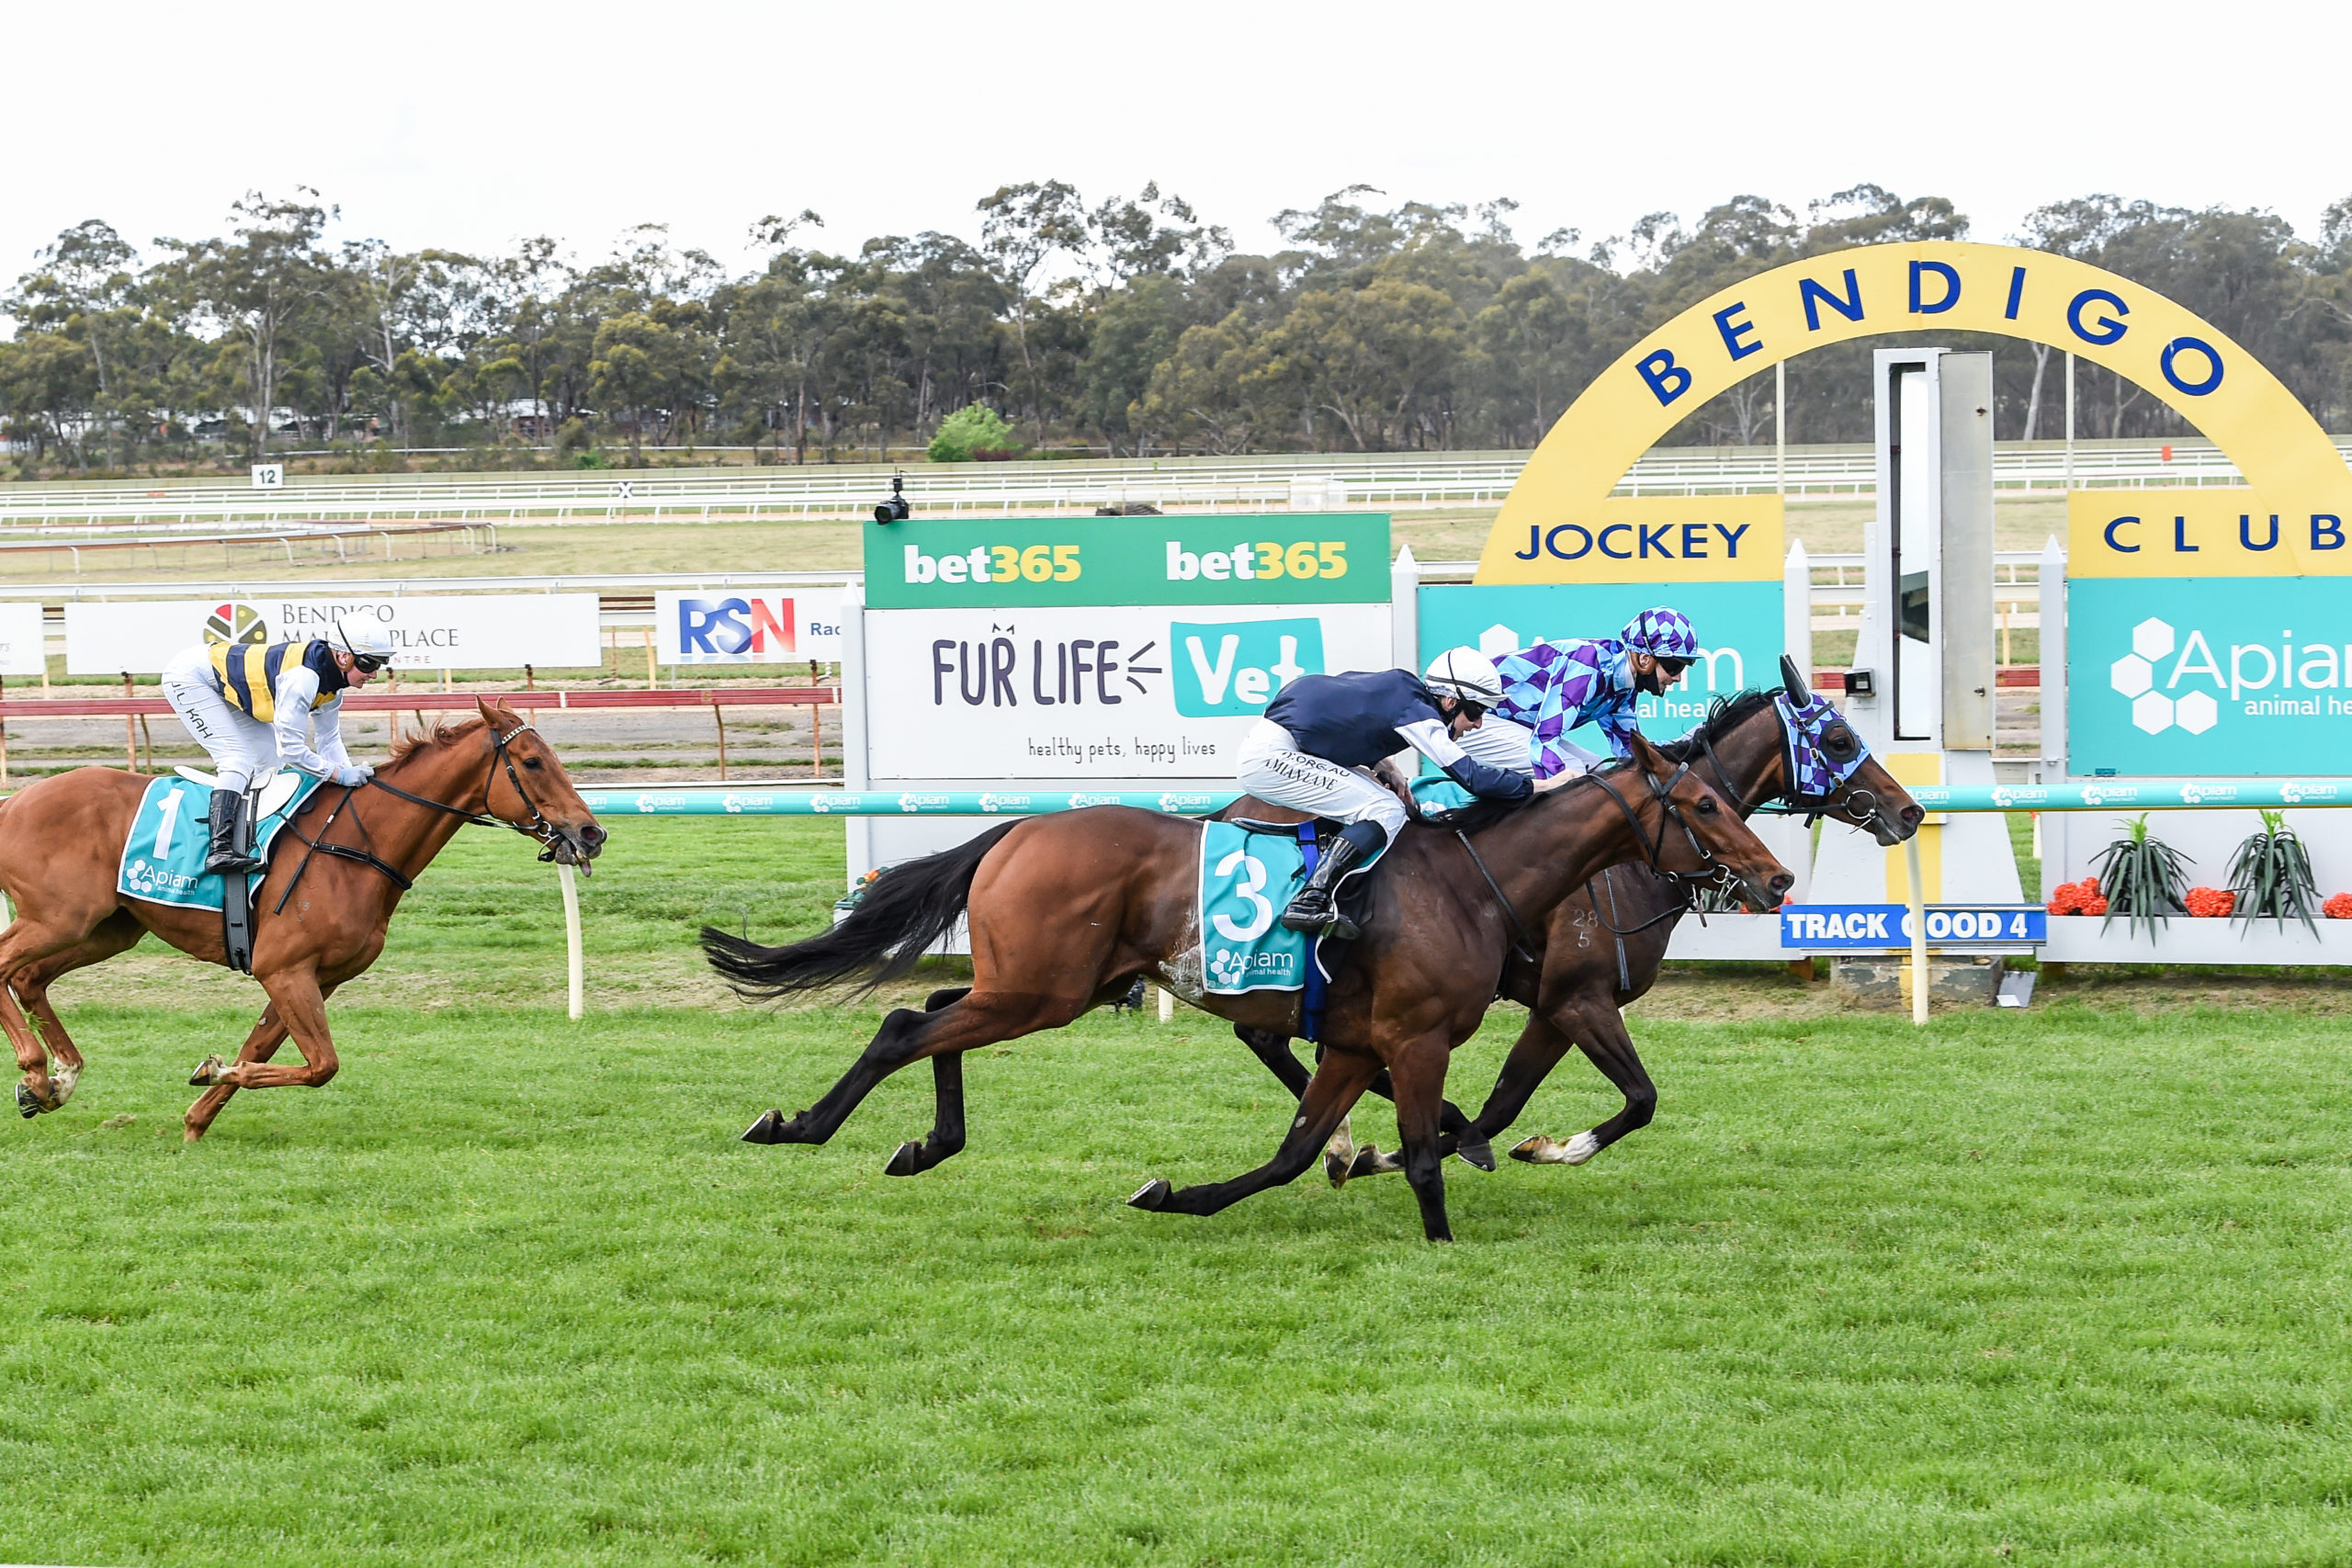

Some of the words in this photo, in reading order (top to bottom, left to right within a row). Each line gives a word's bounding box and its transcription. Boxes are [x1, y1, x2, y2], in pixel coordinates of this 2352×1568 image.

[1634, 260, 2224, 407] BENDIGO
[259, 469, 276, 484] 12
[1514, 524, 1751, 560] JOCKEY
[2104, 514, 2346, 553] CLUB
[904, 544, 1082, 583] bet365
[1166, 540, 1348, 581] bet365
[678, 597, 796, 655] RSN
[933, 637, 1017, 706] FUR
[1033, 638, 1122, 705] LIFE
[1185, 634, 1306, 705] Vet
[2165, 629, 2352, 701] Apia
[2245, 694, 2320, 716] animal
[186, 708, 213, 739] KAH
[1029, 737, 1082, 764] healthy
[1089, 737, 1126, 763] pets,
[1135, 737, 1175, 763] happy
[1182, 736, 1216, 755] lives
[646, 795, 685, 807] Apiam
[734, 795, 773, 807] Apiam
[820, 795, 860, 807] Apiam
[909, 794, 949, 806] Apiam
[989, 794, 1030, 806] Apiam
[1079, 794, 1120, 805] Apiam
[1169, 794, 1211, 806] Apiam
[2001, 787, 2047, 800] Apiam
[2091, 786, 2137, 798] Apiam
[2190, 784, 2237, 797] Apiam
[2290, 784, 2337, 796] Apiam
[153, 788, 185, 860] 1
[140, 865, 198, 889] Apiam
[1212, 849, 1273, 942] 3
[1787, 913, 1889, 939] TRACK
[2009, 913, 2028, 938] 4
[1228, 949, 1294, 975] Apiam
